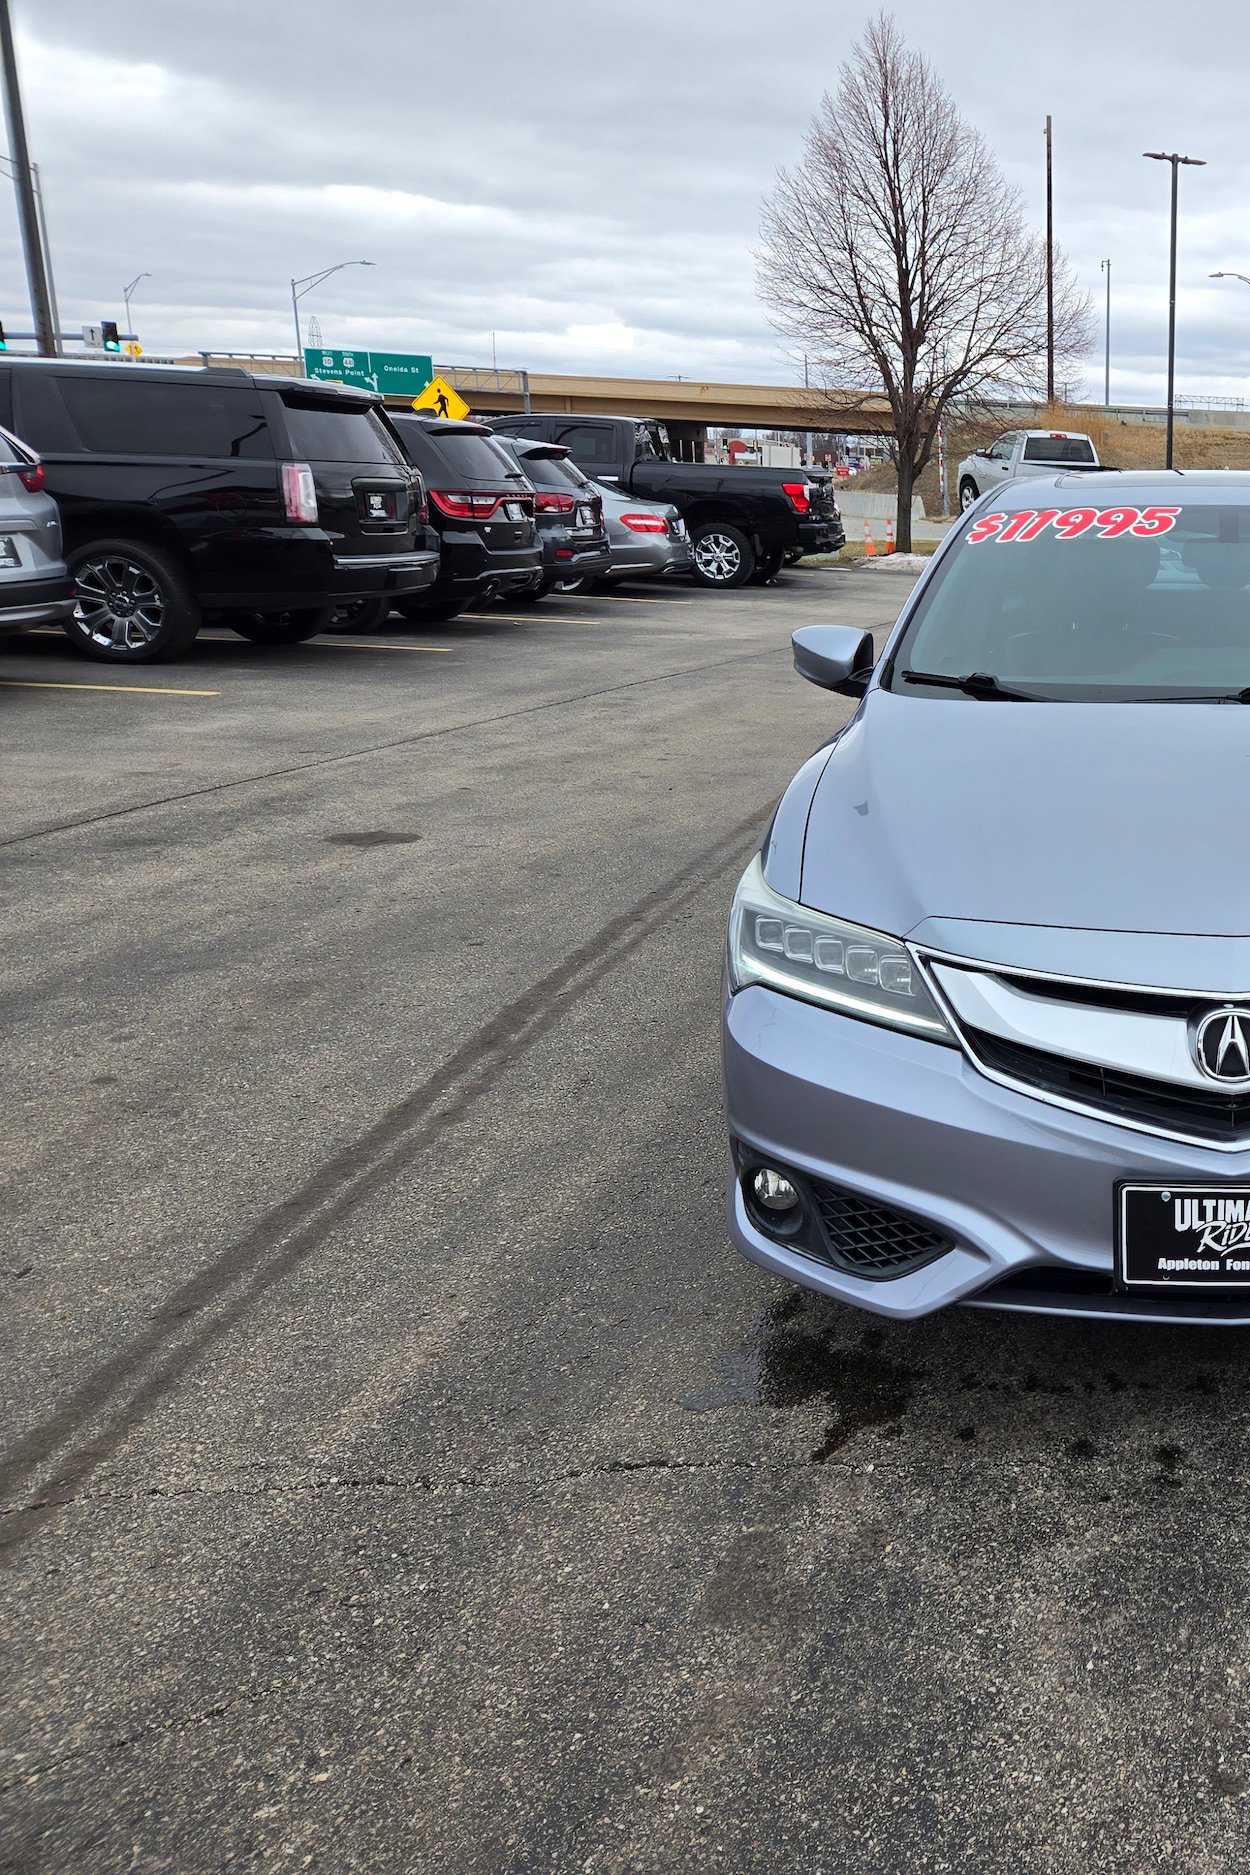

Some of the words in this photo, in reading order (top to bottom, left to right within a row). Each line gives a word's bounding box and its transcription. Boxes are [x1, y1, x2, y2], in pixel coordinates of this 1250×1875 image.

[314, 367, 342, 375] Stevens
[344, 369, 365, 377] Point
[383, 365, 408, 373] Oneida
[410, 366, 420, 374] St
[965, 506, 1182, 544] $11995
[1157, 1257, 1220, 1271] Appleton
